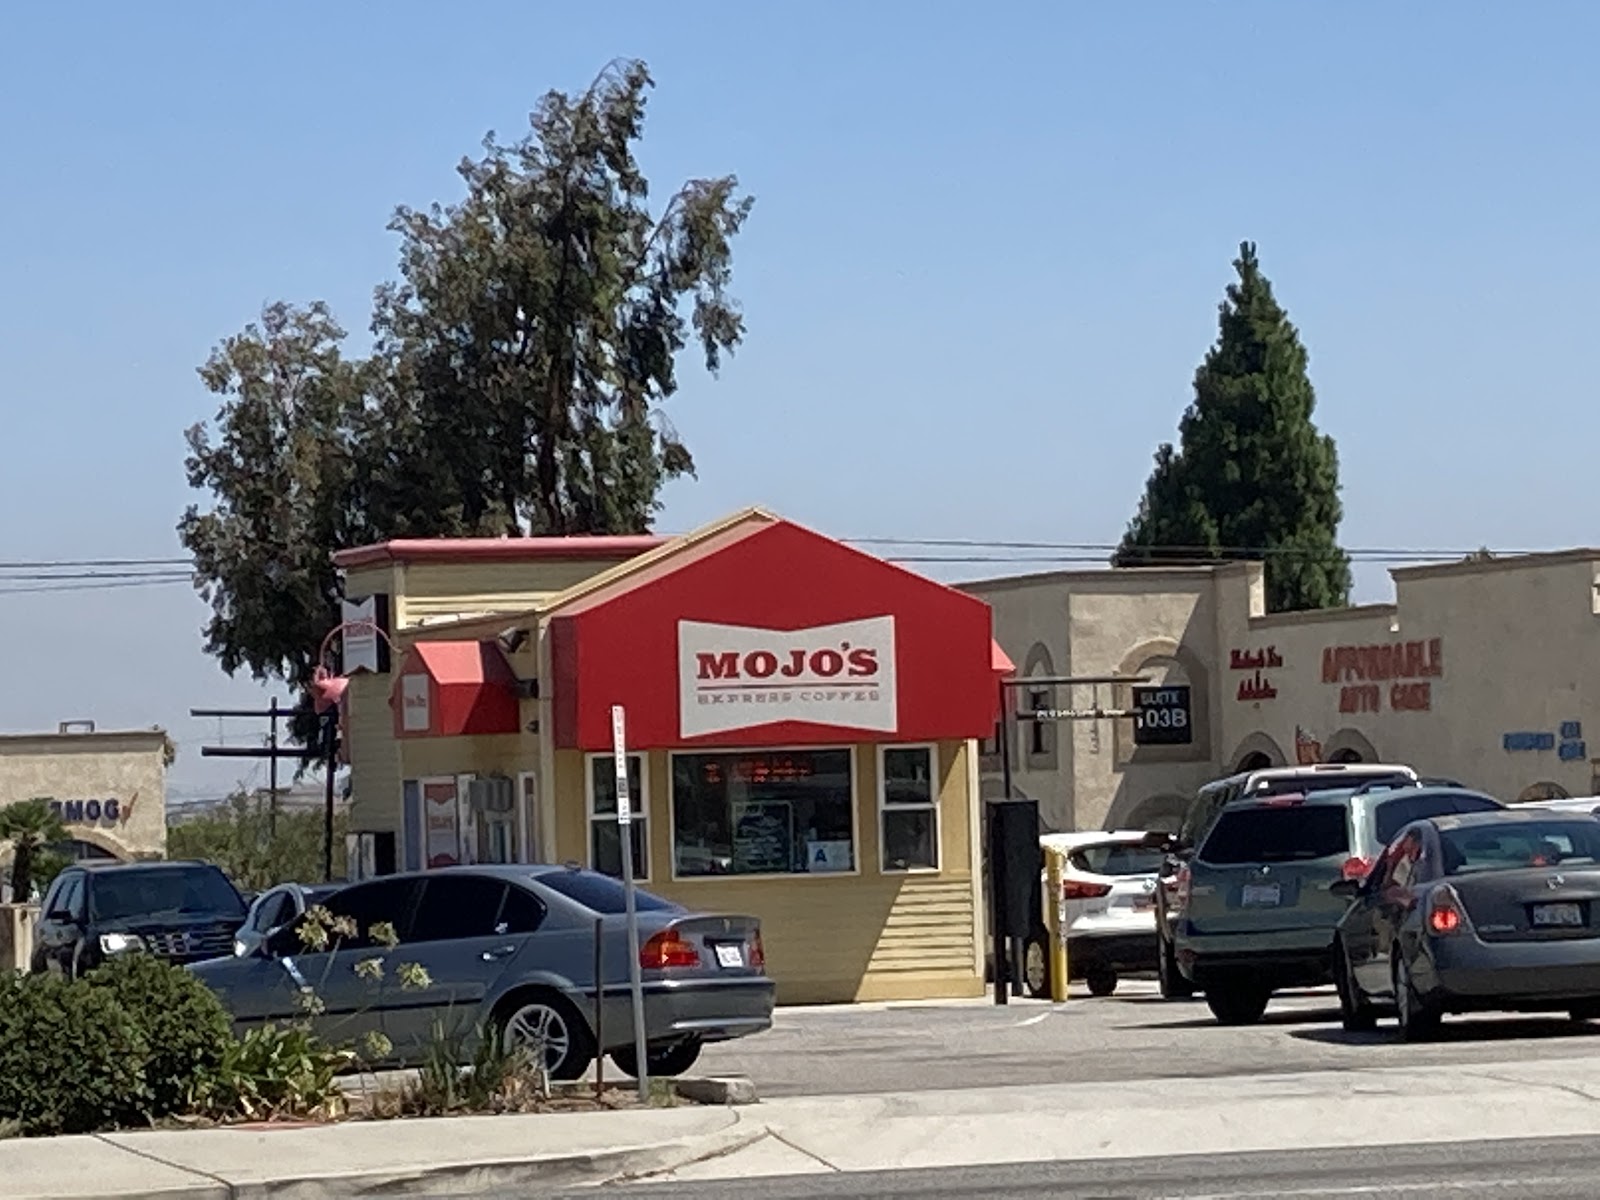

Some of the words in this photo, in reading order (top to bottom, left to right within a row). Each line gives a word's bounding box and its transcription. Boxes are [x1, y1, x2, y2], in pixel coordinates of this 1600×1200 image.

[696, 641, 879, 680] MOJO'S
[698, 692, 792, 705] EXPRESS
[800, 690, 880, 702] COFFEE
